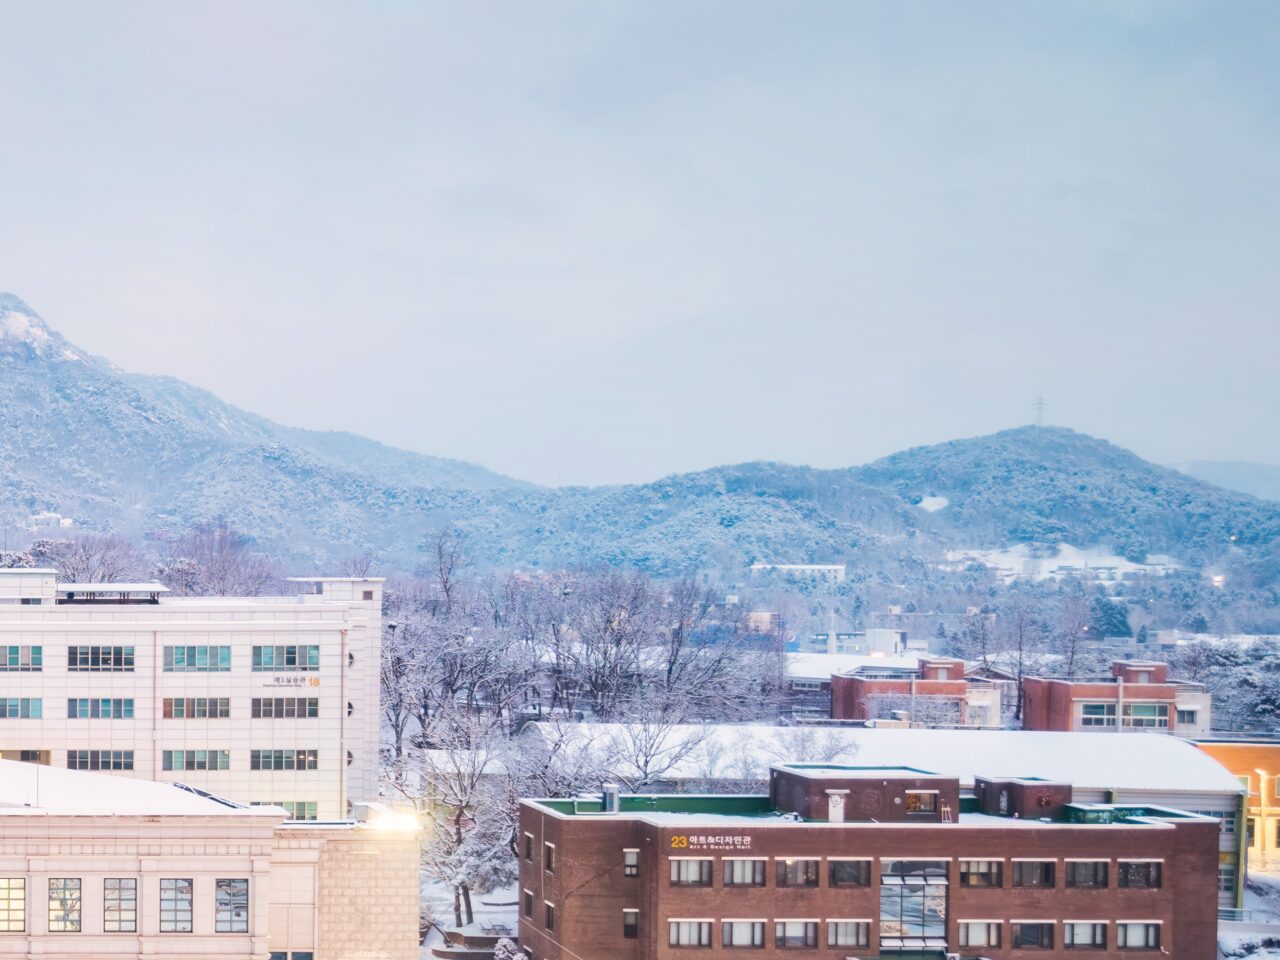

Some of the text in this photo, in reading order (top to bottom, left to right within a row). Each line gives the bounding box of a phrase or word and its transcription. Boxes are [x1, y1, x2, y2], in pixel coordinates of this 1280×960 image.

[309, 677, 321, 687] 18
[671, 835, 752, 848] 23 아트&디자인관
